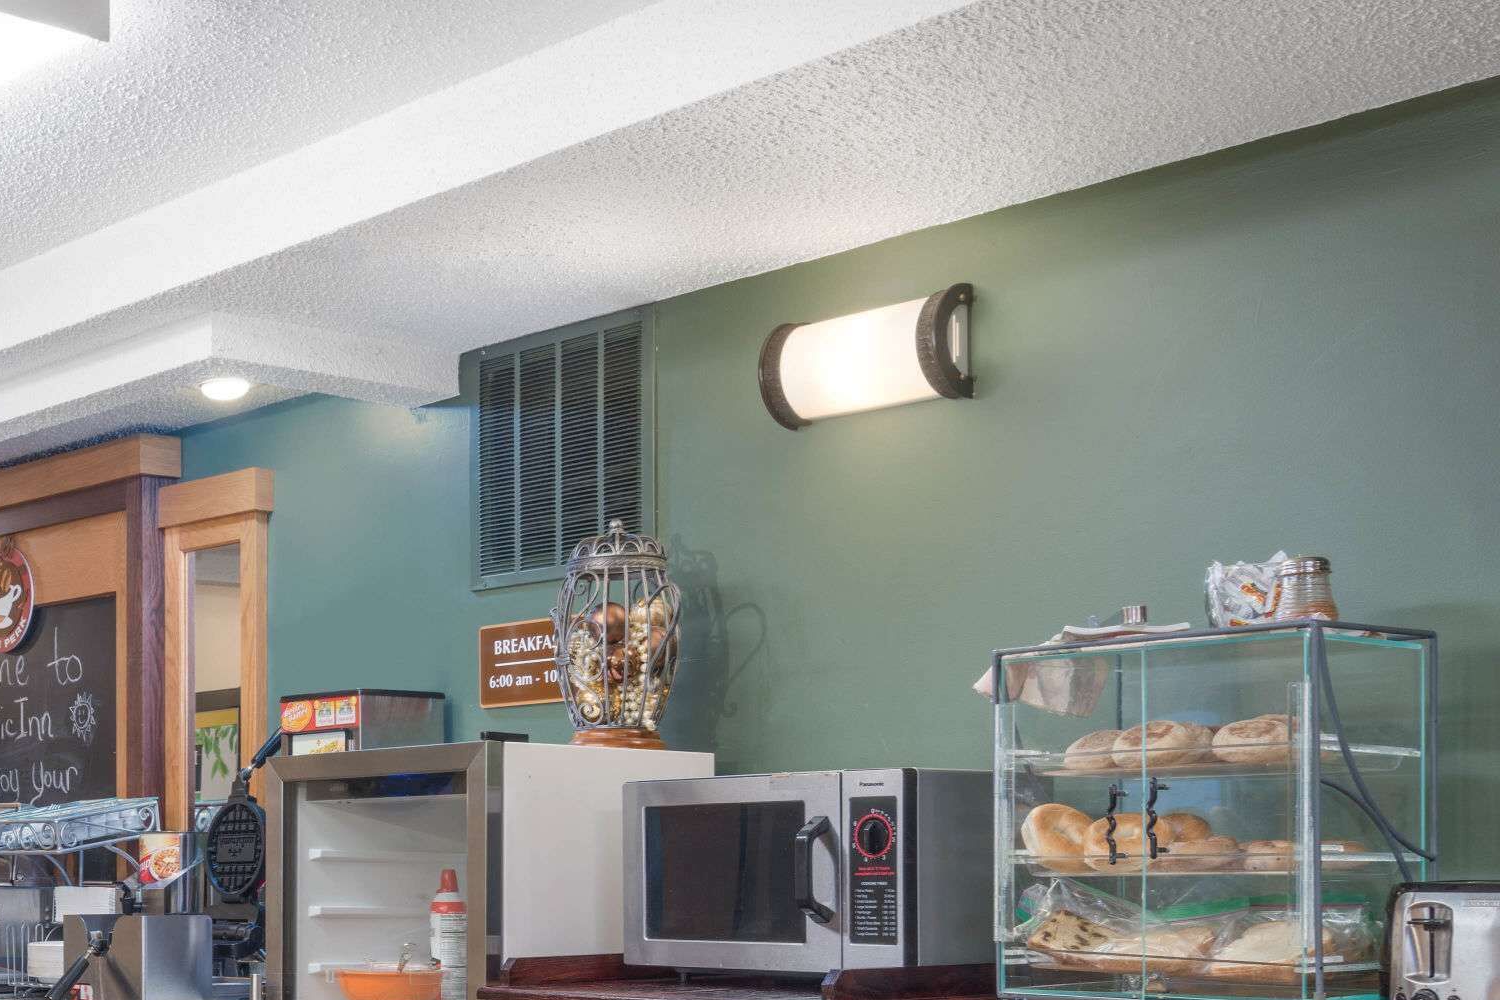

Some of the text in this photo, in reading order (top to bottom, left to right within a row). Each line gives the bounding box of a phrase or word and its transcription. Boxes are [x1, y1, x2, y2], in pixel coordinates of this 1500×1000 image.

[4, 616, 27, 648] PERK
[494, 634, 558, 656] BREAKFA
[47, 627, 82, 686] to
[489, 673, 513, 689] 6:00
[515, 675, 533, 686] am
